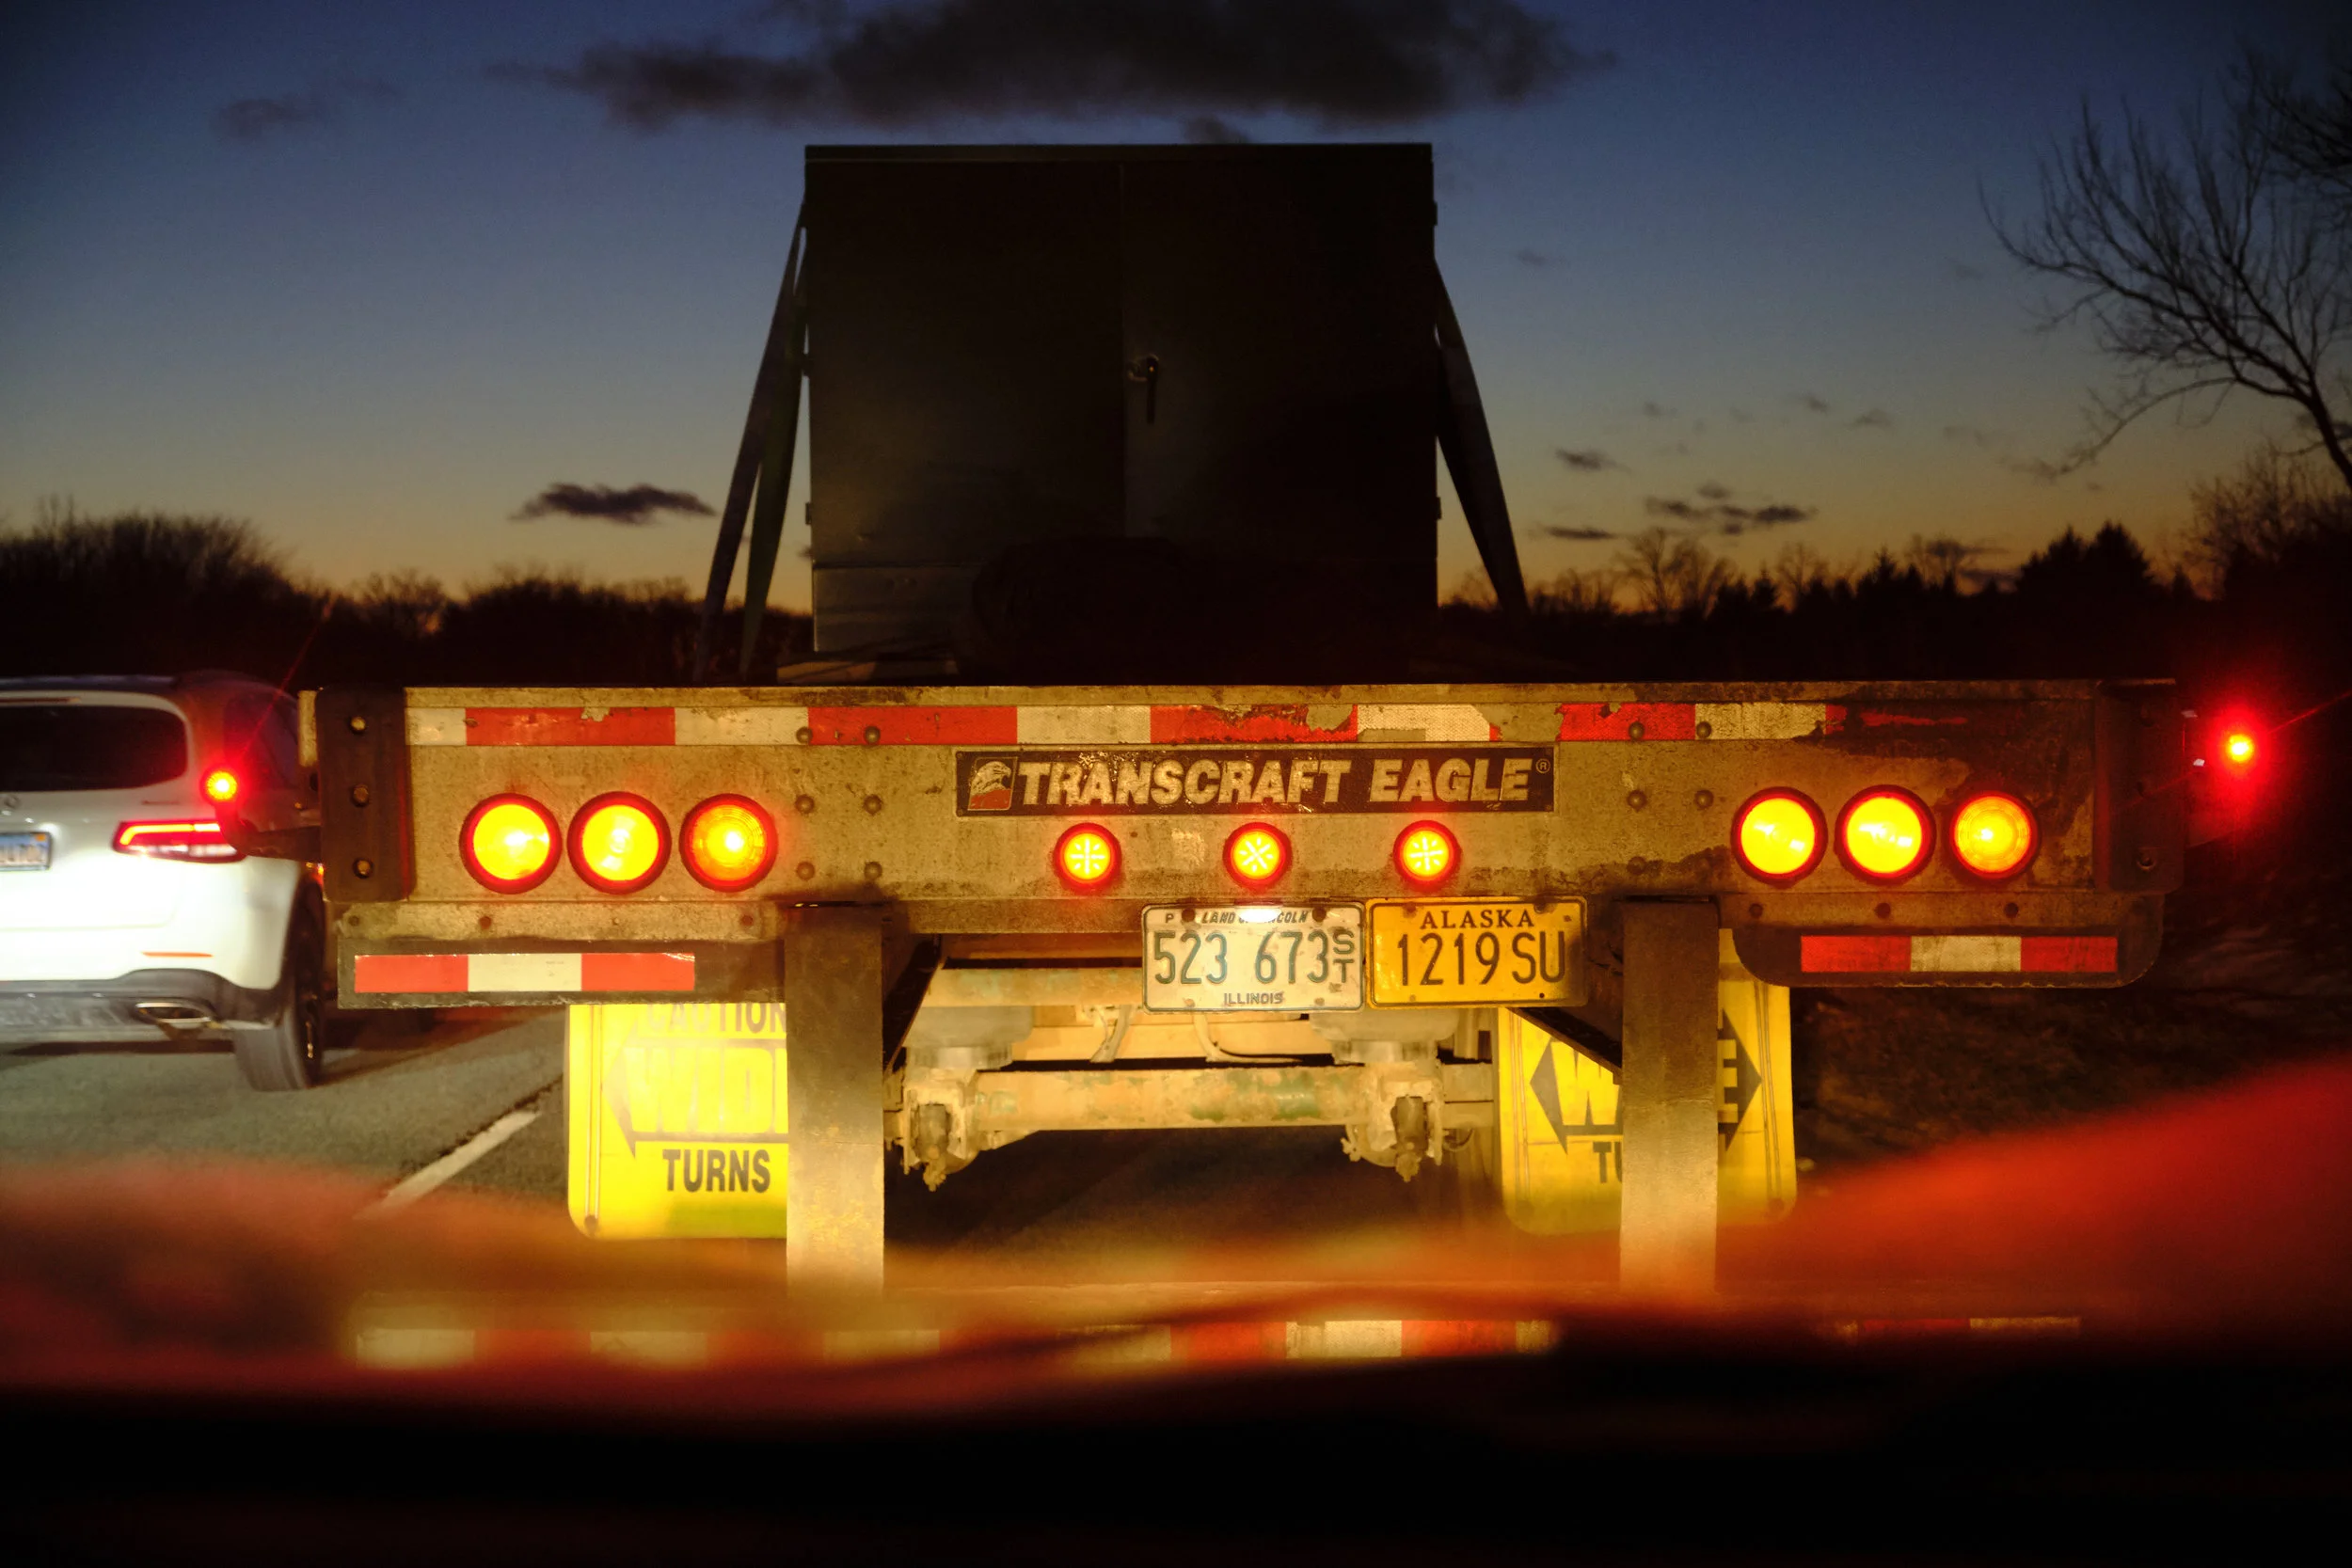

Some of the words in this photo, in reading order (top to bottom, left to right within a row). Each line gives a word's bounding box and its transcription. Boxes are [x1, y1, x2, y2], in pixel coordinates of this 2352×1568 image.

[1018, 758, 1352, 805] TRANSCRAFT
[1369, 757, 1534, 803] EAGLE
[1201, 911, 1236, 924] LAND
[1420, 909, 1535, 929] ALASKA
[1153, 929, 1228, 985] 523
[1254, 929, 1329, 985] 673
[1223, 992, 1284, 1005] ILLINOIS
[661, 1148, 771, 1194] TURNS
